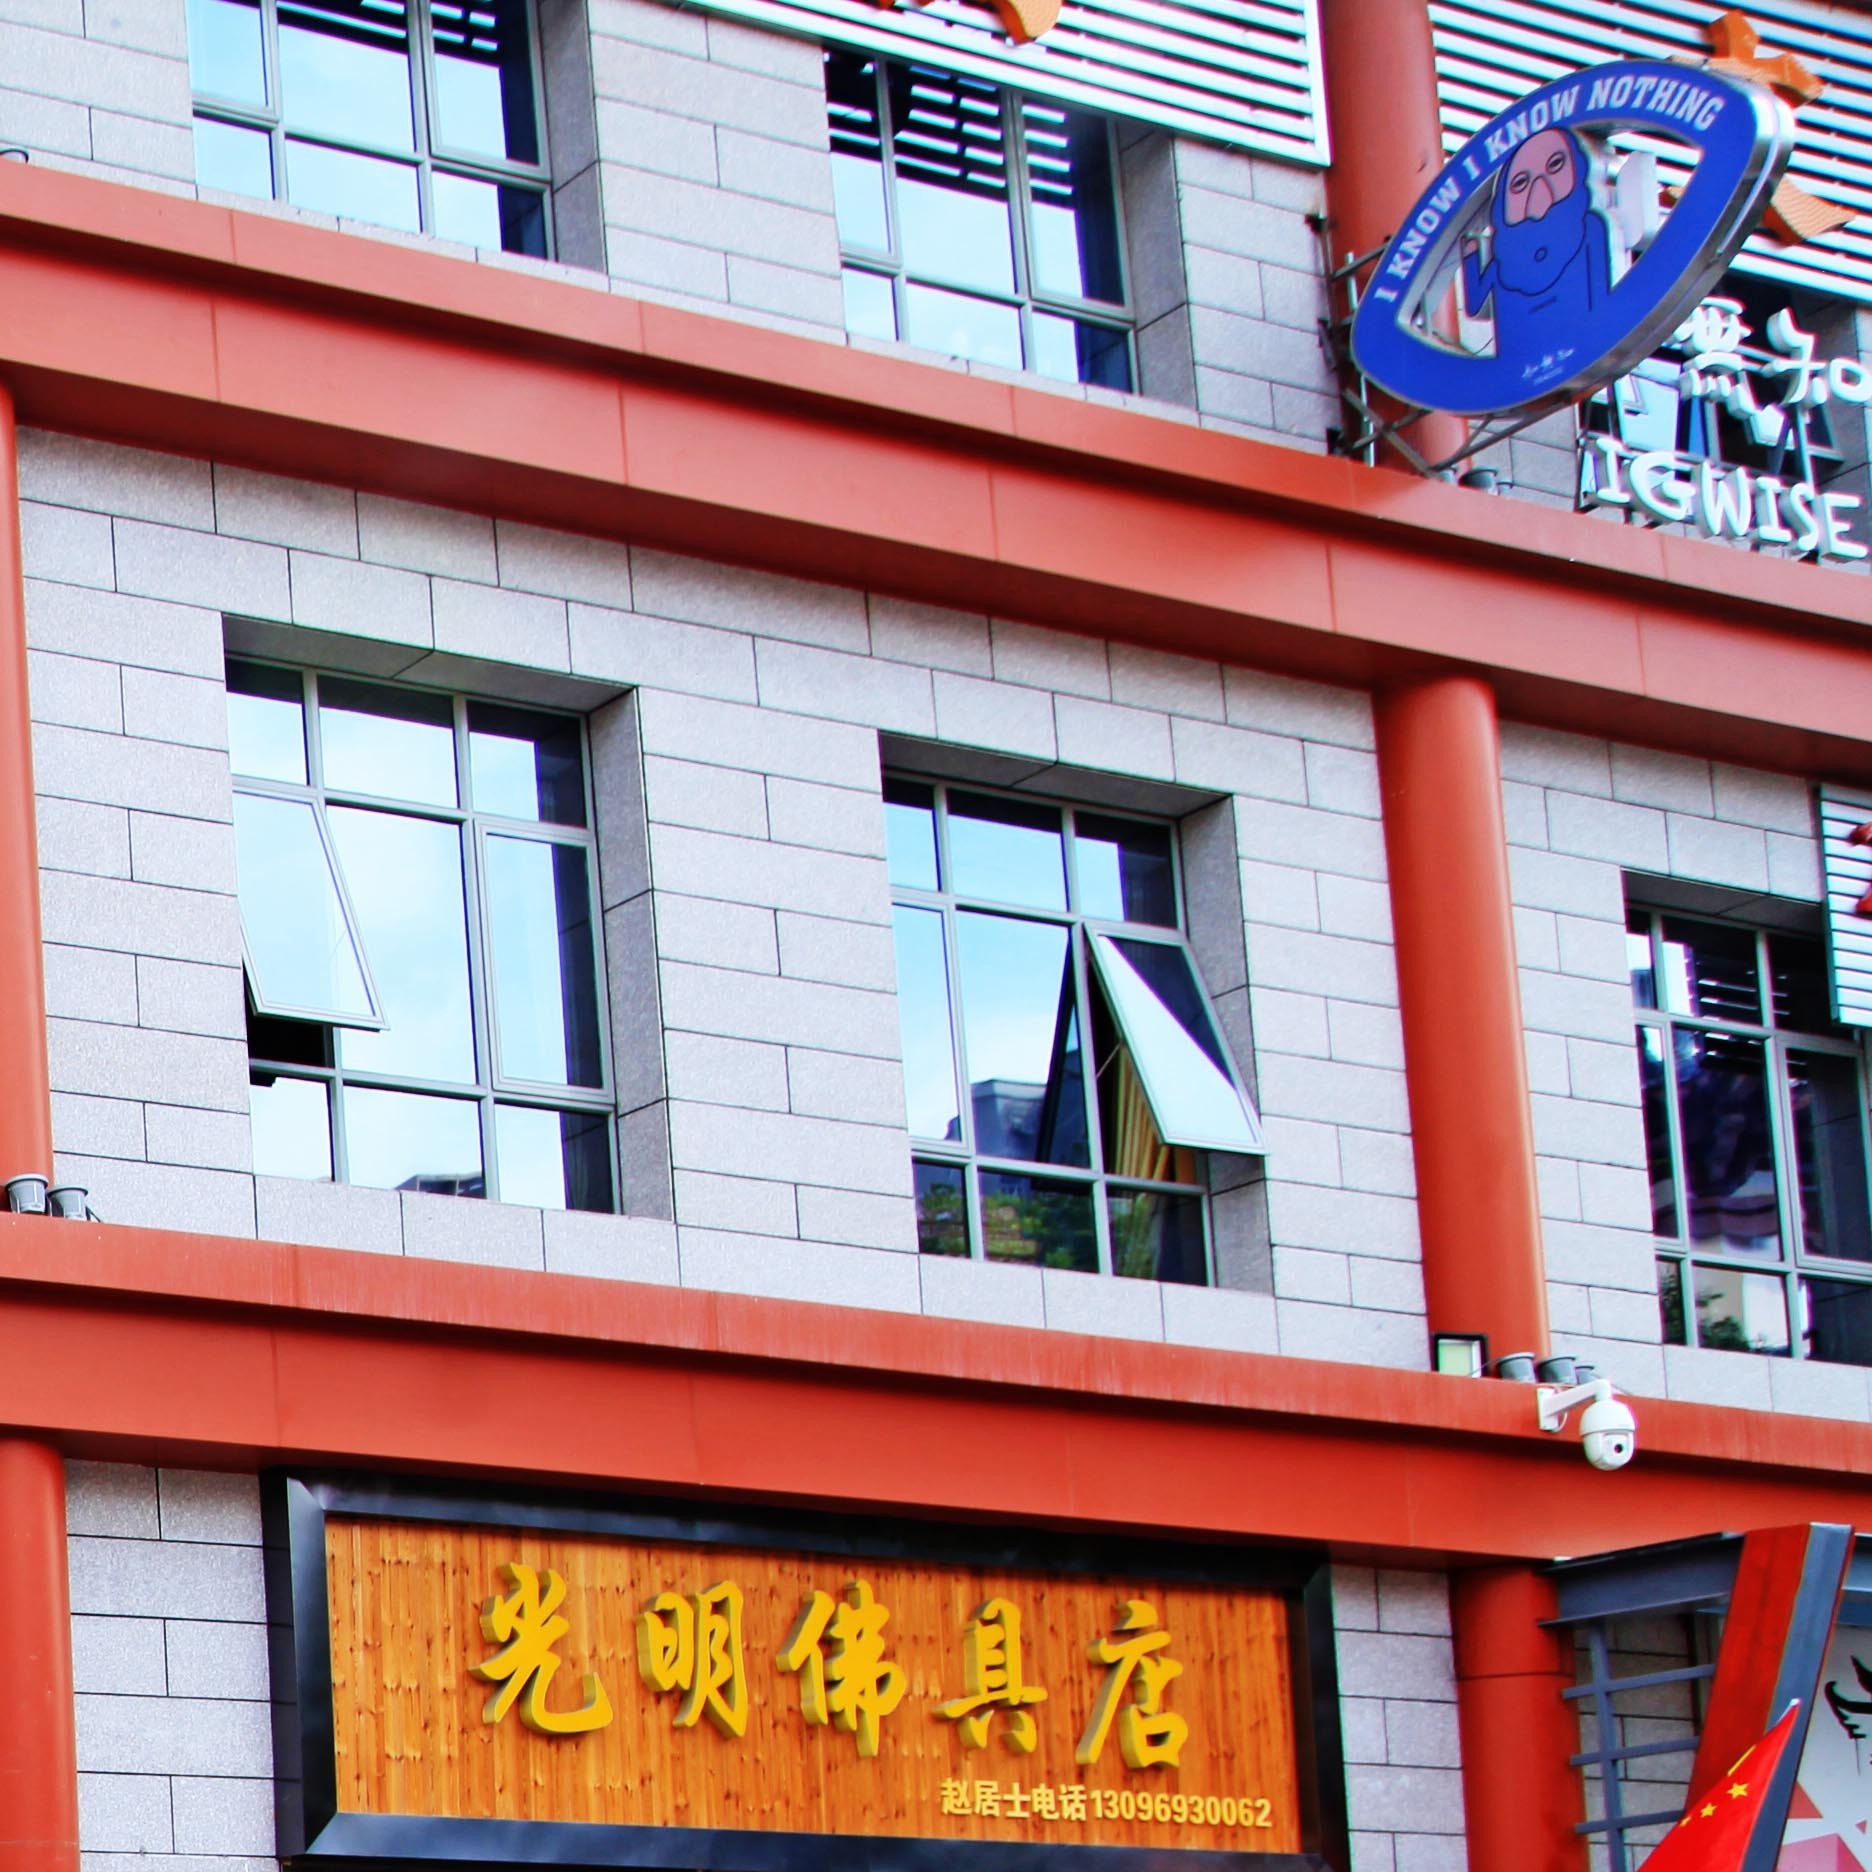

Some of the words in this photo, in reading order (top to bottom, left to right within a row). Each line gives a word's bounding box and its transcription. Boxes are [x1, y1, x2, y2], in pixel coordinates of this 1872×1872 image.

[1374, 286, 1398, 304] I
[1386, 176, 1462, 281] KNOW
[1461, 154, 1481, 182] I
[1483, 85, 1582, 162] KNOW
[1584, 74, 1726, 132] NOTHING
[1597, 437, 1868, 558] IGWISE
[473, 1562, 1193, 1772] 光明佛具店
[939, 1777, 1273, 1828] 赵居士电话13096930062
